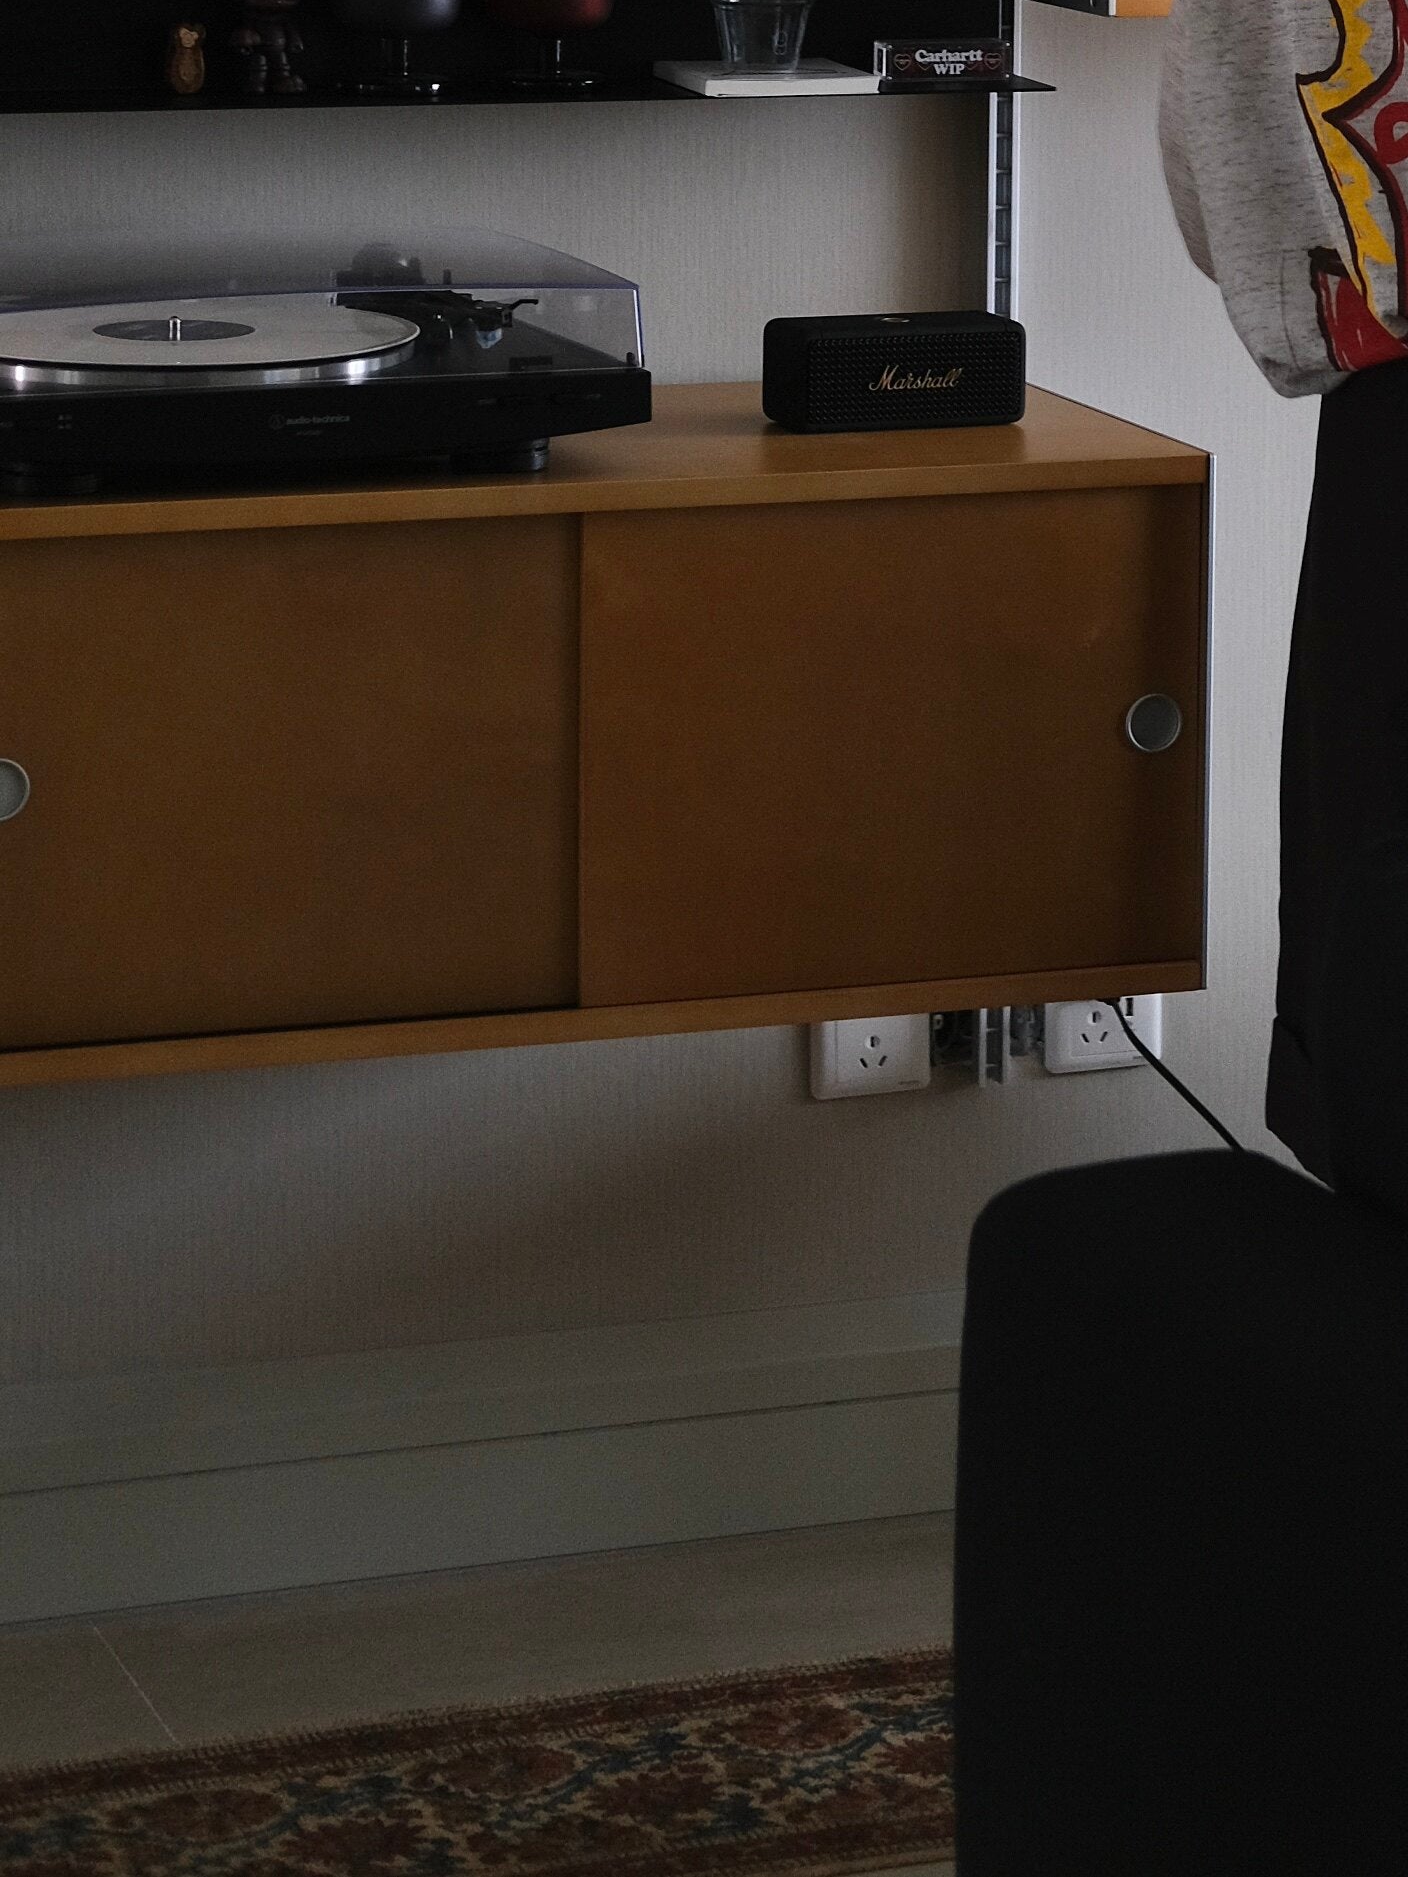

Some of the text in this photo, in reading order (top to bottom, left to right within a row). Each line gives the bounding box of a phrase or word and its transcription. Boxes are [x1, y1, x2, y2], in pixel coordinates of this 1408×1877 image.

[914, 49, 983, 63] Carhartt
[933, 63, 965, 75] WIP
[868, 364, 963, 391] Marshall
